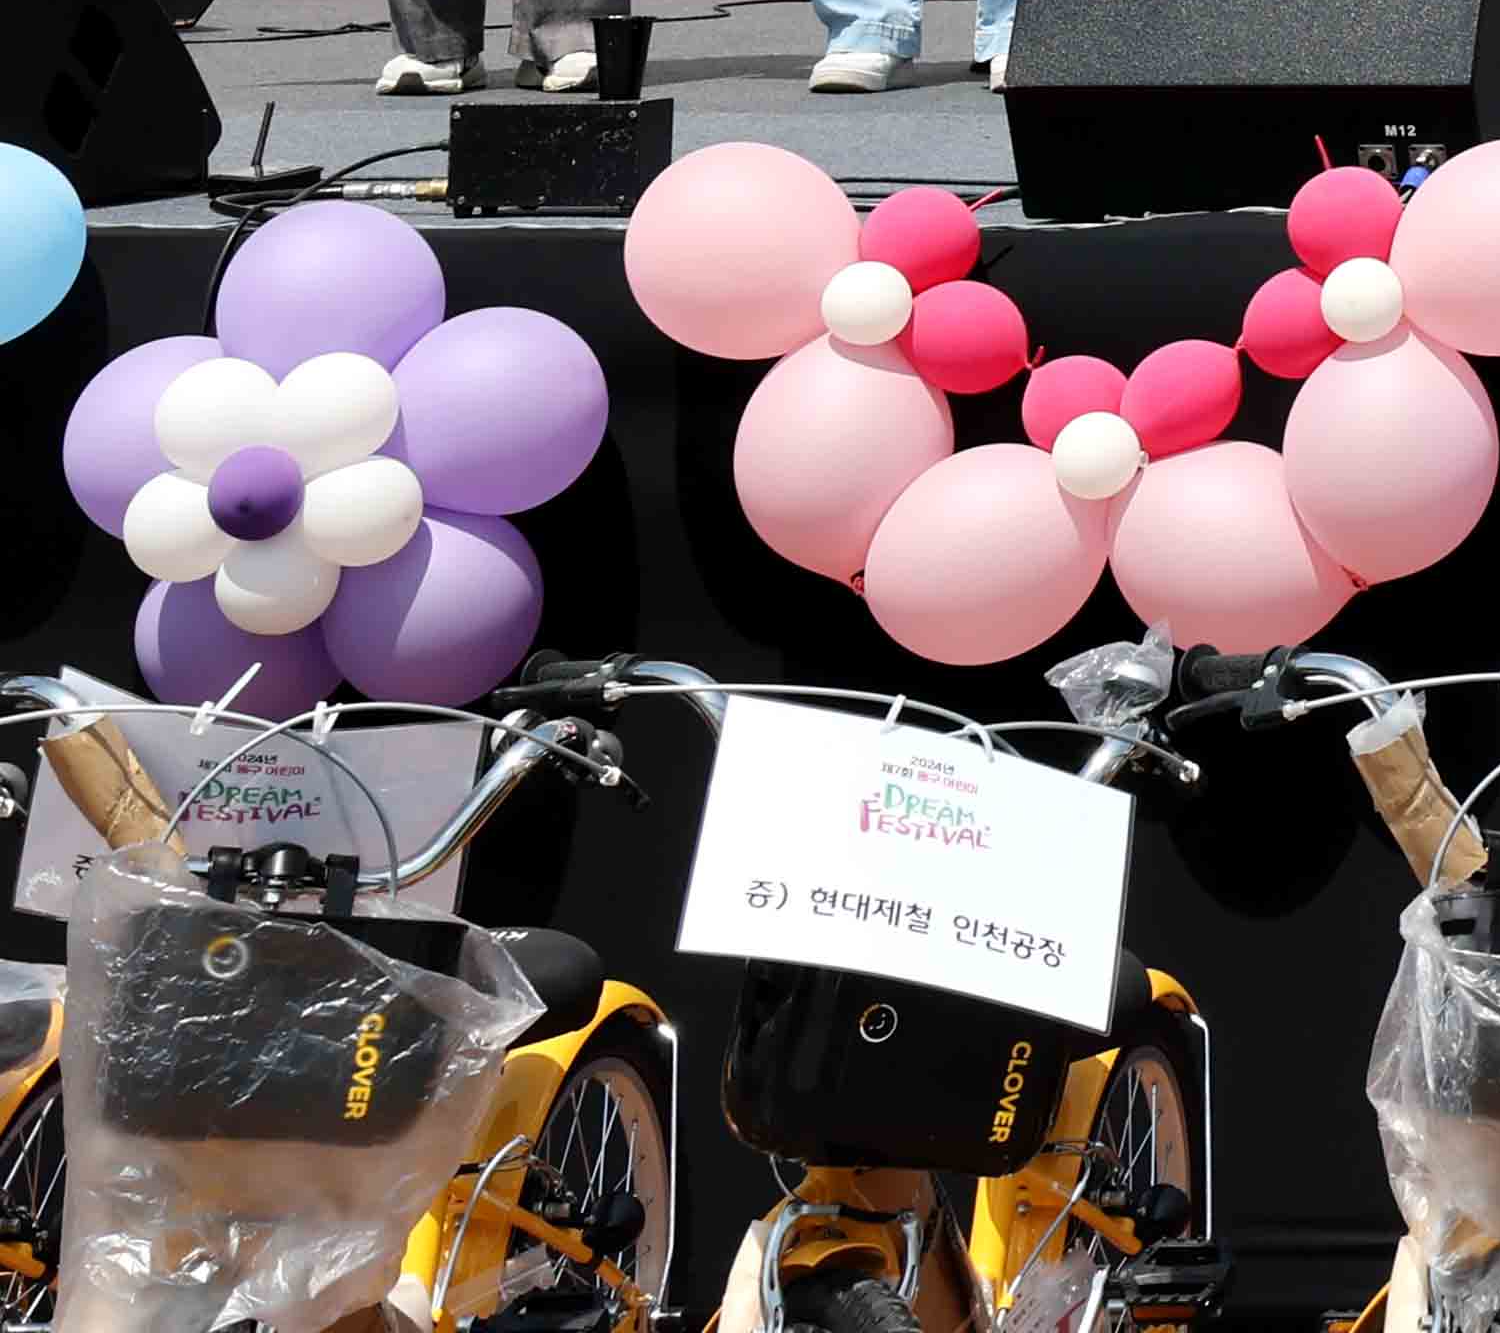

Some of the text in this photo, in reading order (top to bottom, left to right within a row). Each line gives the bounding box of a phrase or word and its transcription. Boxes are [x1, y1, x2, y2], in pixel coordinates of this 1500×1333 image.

[1385, 124, 1417, 137] M12
[203, 780, 303, 807] DREAM
[885, 783, 976, 826] DREAM
[860, 798, 992, 850] FESTIVAL
[744, 880, 1066, 968] 증) 현대제철 인천공장
[344, 1013, 386, 1122] CLOVER
[988, 1040, 1032, 1143] CLOVER
